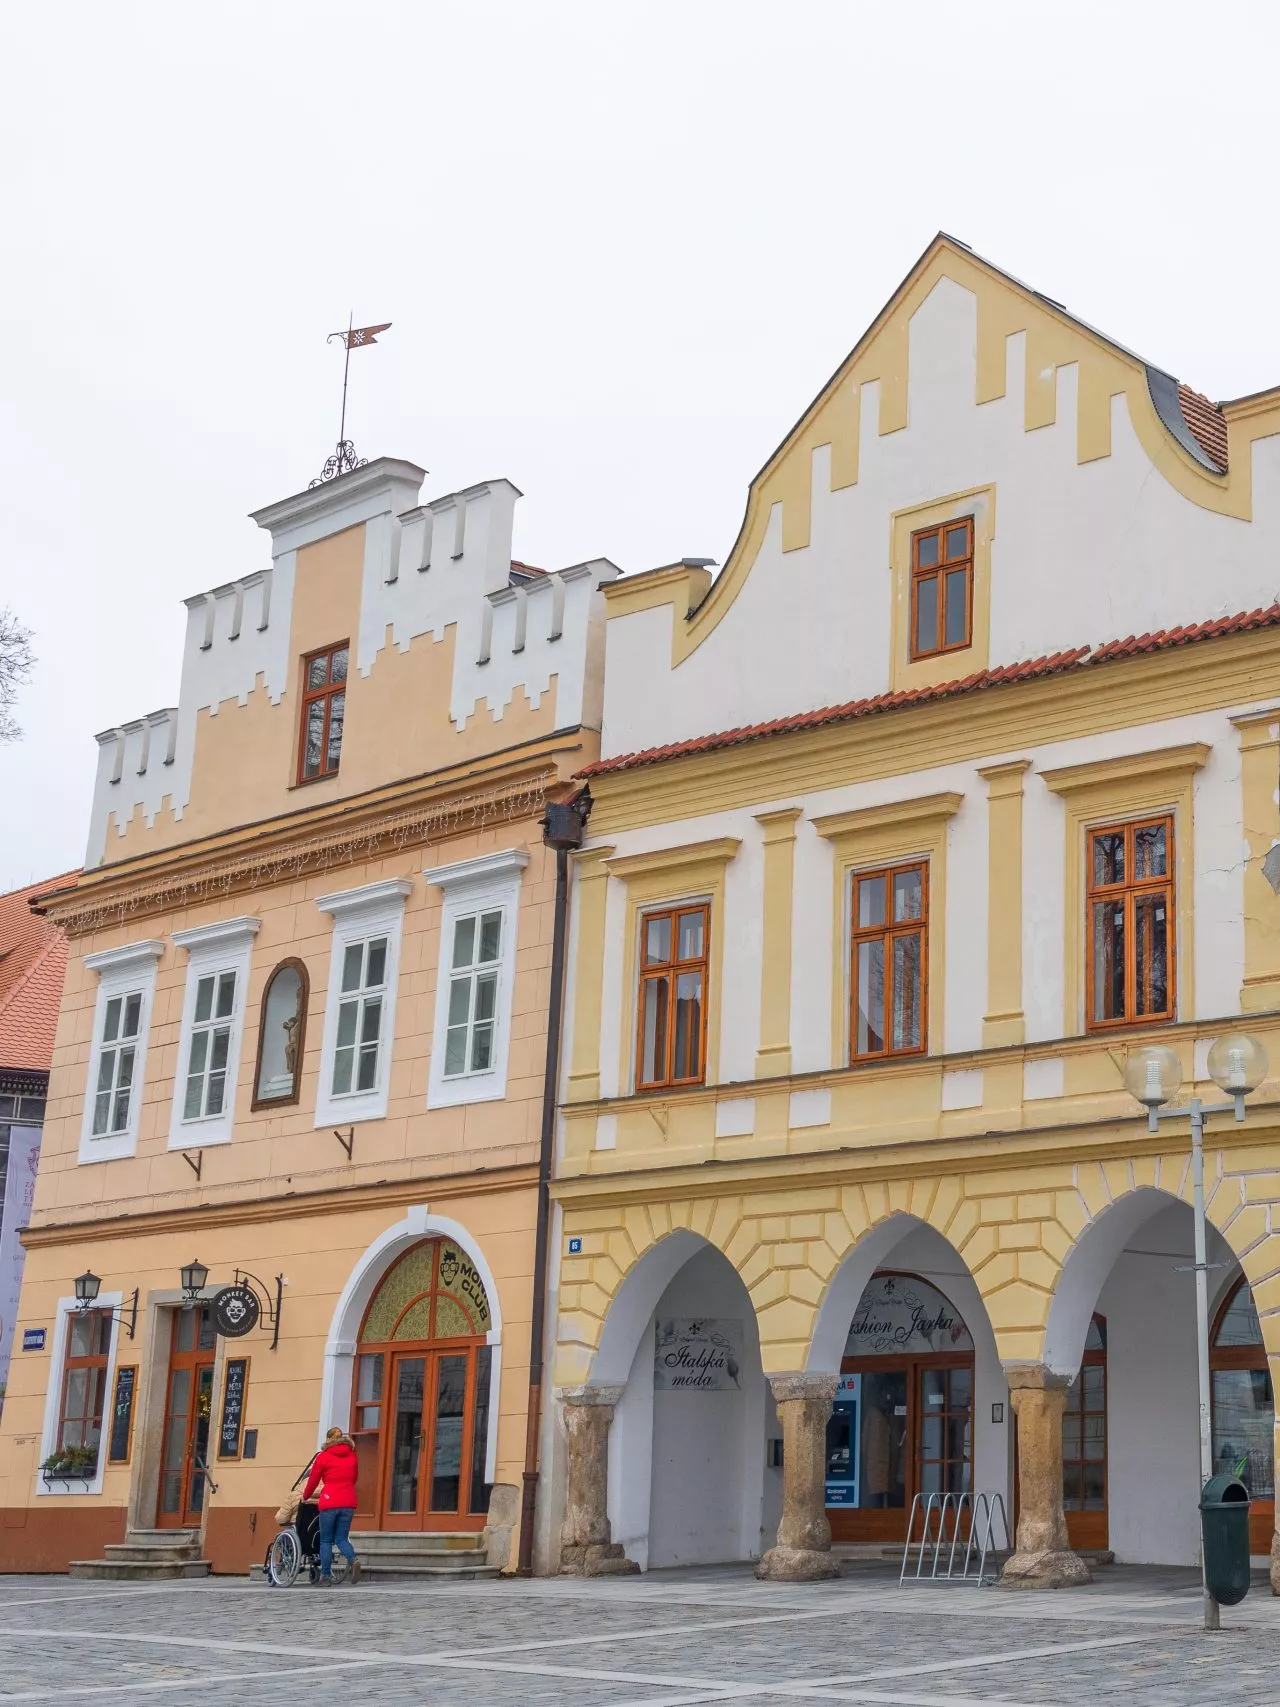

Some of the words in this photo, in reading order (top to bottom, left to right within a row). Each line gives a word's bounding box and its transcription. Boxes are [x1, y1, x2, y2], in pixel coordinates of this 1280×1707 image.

[461, 1279, 488, 1321] CLUB
[849, 1312, 892, 1335] ashion
[895, 1305, 954, 1344] Jarka
[665, 1345, 725, 1377] Italská
[672, 1370, 712, 1386] móda
